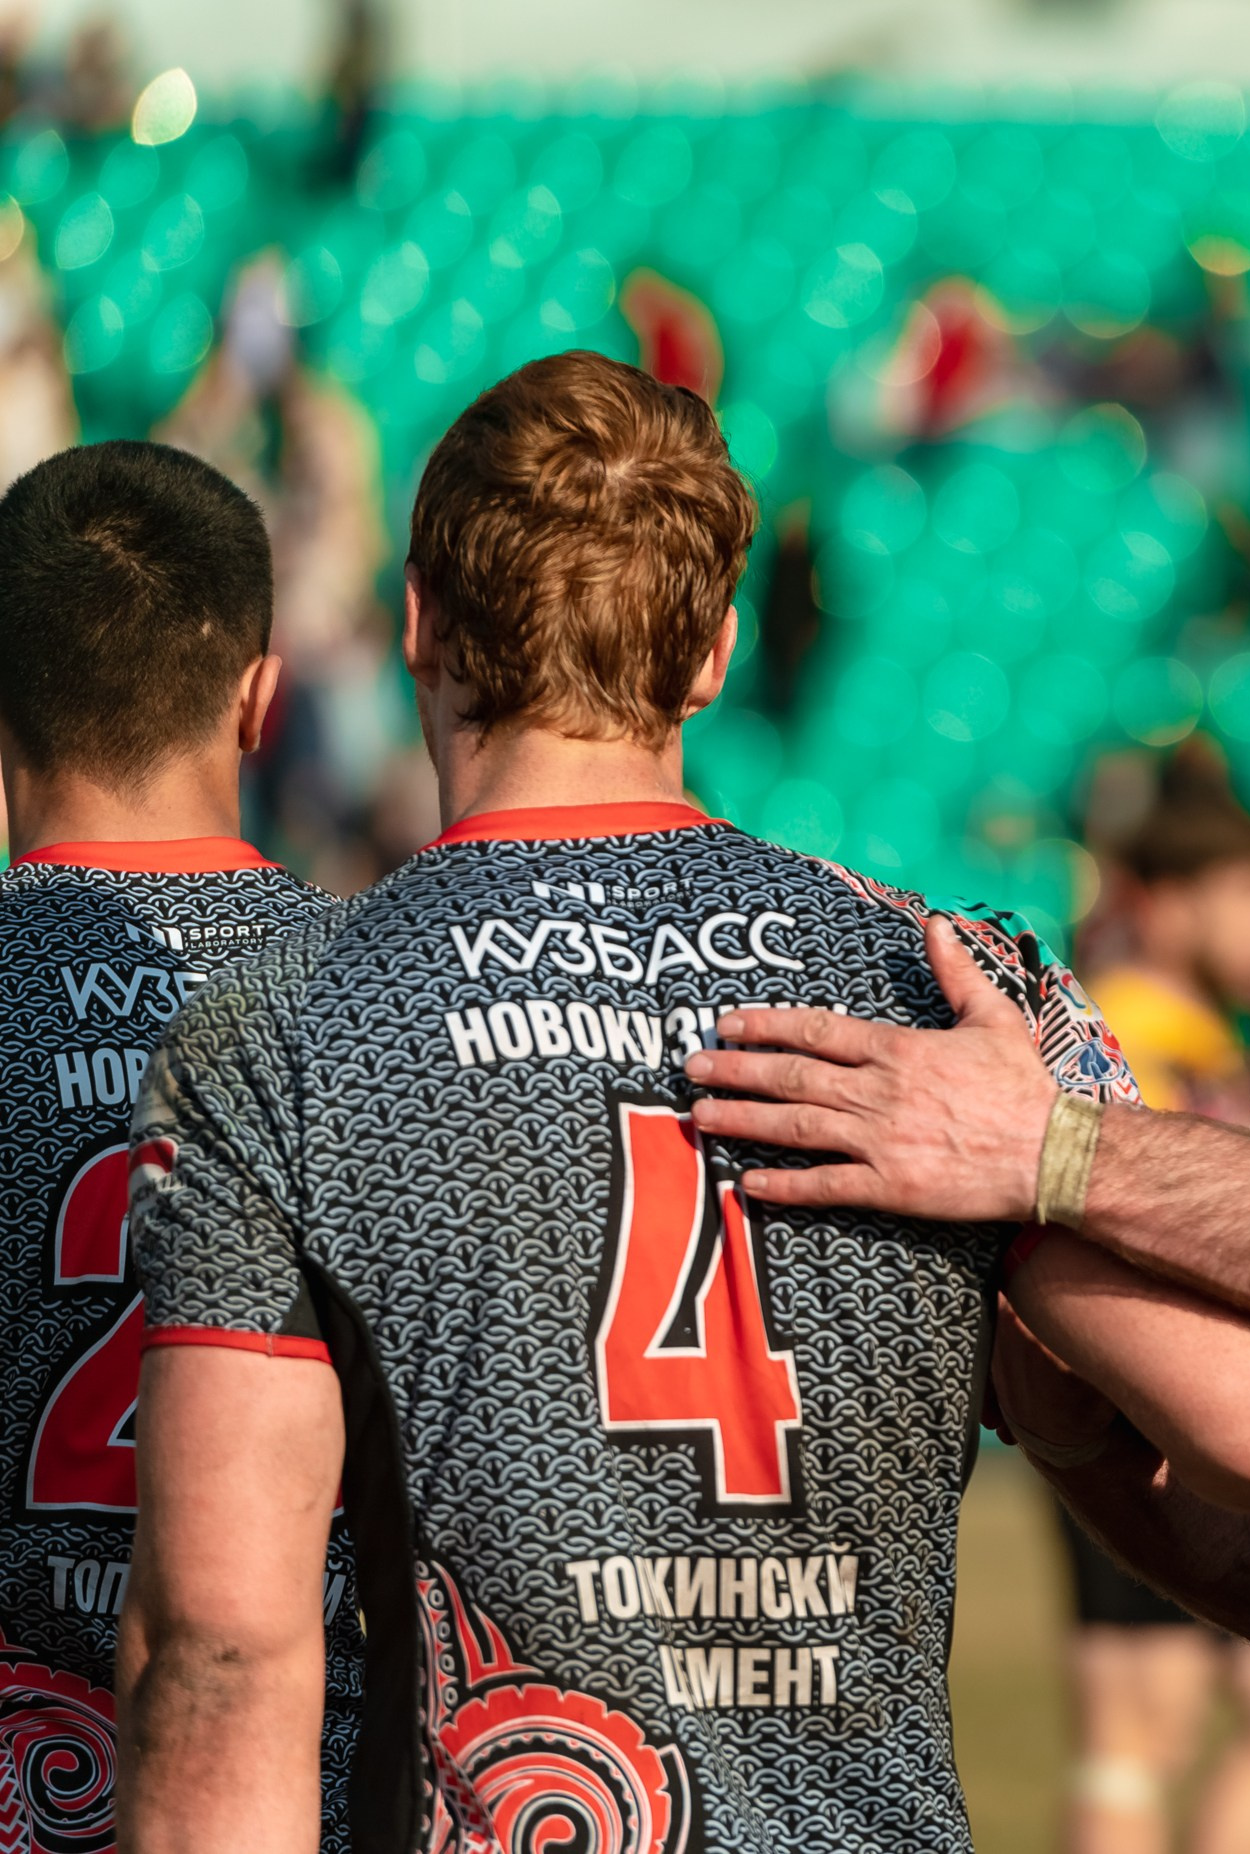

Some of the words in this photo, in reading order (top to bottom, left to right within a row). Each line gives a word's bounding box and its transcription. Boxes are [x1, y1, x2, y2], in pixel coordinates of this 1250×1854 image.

[612, 877, 694, 900] SPORT
[189, 924, 265, 940] SPORT
[191, 938, 264, 949] LABORATORY
[450, 911, 803, 985] КУЗБАСС
[445, 1000, 848, 1070] НОВОКУЗ
[595, 1102, 802, 1504] 4
